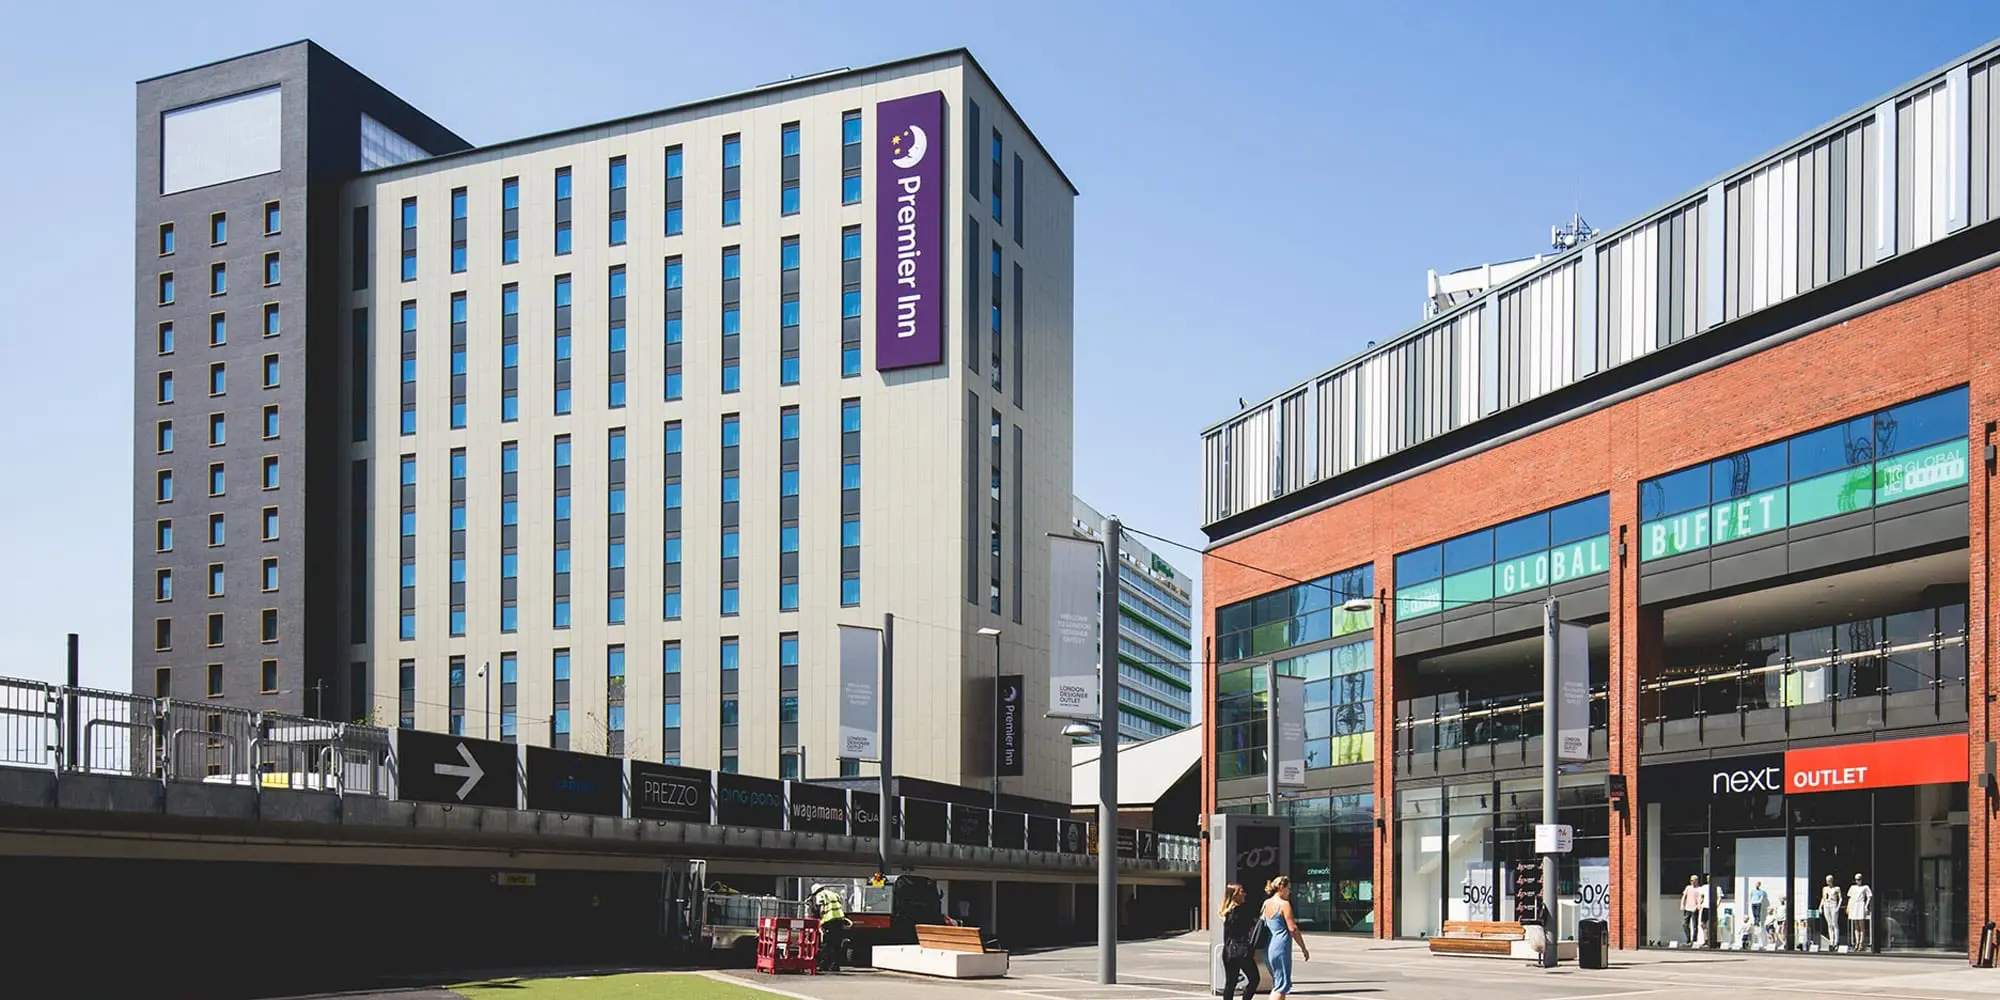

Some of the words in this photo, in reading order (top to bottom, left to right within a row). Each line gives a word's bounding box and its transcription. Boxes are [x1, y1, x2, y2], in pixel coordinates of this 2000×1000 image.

[897, 175, 921, 288] Premier
[897, 294, 921, 339] Inn
[1905, 450, 1960, 473] GLOBAL
[1652, 494, 1774, 556] BUFFET
[1503, 542, 1602, 593] GLOBAL
[1059, 685, 1085, 693] LONDON
[1059, 691, 1089, 699] DESIGNER
[1005, 705, 1016, 748] Premier
[1005, 749, 1016, 766] Inn
[1713, 766, 1780, 794] next
[1793, 766, 1868, 789] OUTLET
[644, 780, 698, 807] PREZZO
[793, 803, 844, 821] wagamama
[1462, 885, 1494, 904] 50%
[1573, 884, 1610, 904] 50%
